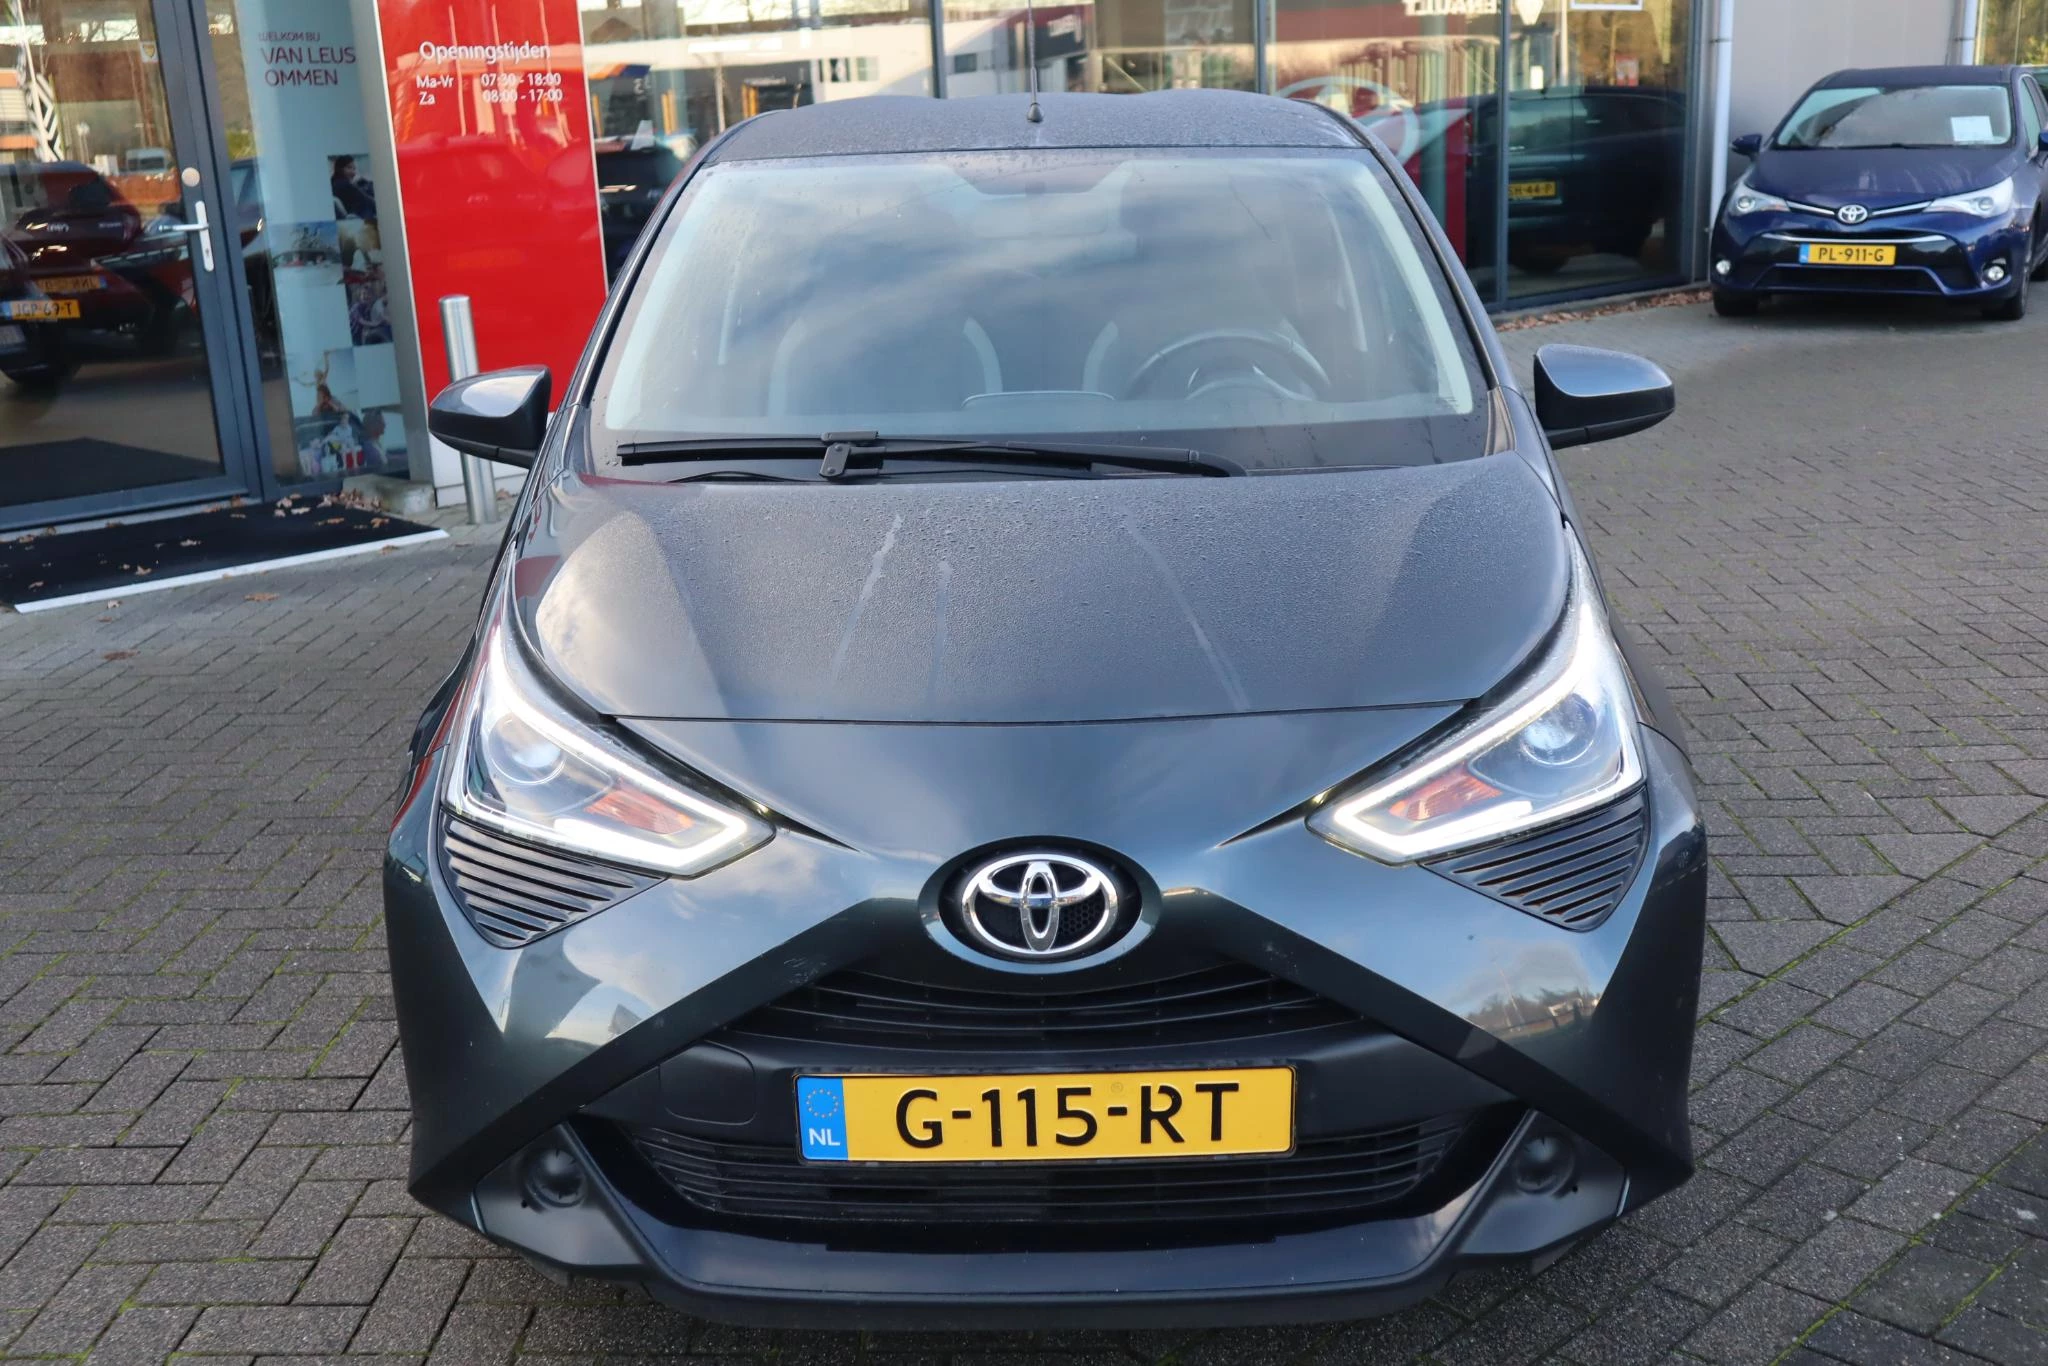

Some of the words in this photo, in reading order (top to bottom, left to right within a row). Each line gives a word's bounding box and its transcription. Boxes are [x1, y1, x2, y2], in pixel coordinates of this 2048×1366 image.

[260, 47, 303, 64] VAN
[307, 47, 356, 64] LEUS
[418, 40, 551, 65] Openingstijden
[264, 69, 339, 87] OMMEN
[415, 74, 455, 89] Ma-Vr
[527, 72, 562, 87] 18:00
[418, 91, 436, 106] Za
[481, 88, 518, 103] 08:00
[529, 88, 564, 103] 17:00
[1818, 247, 1885, 263] PL-911-G
[808, 1128, 841, 1147] NL
[895, 1081, 1240, 1149] G-115-RT
